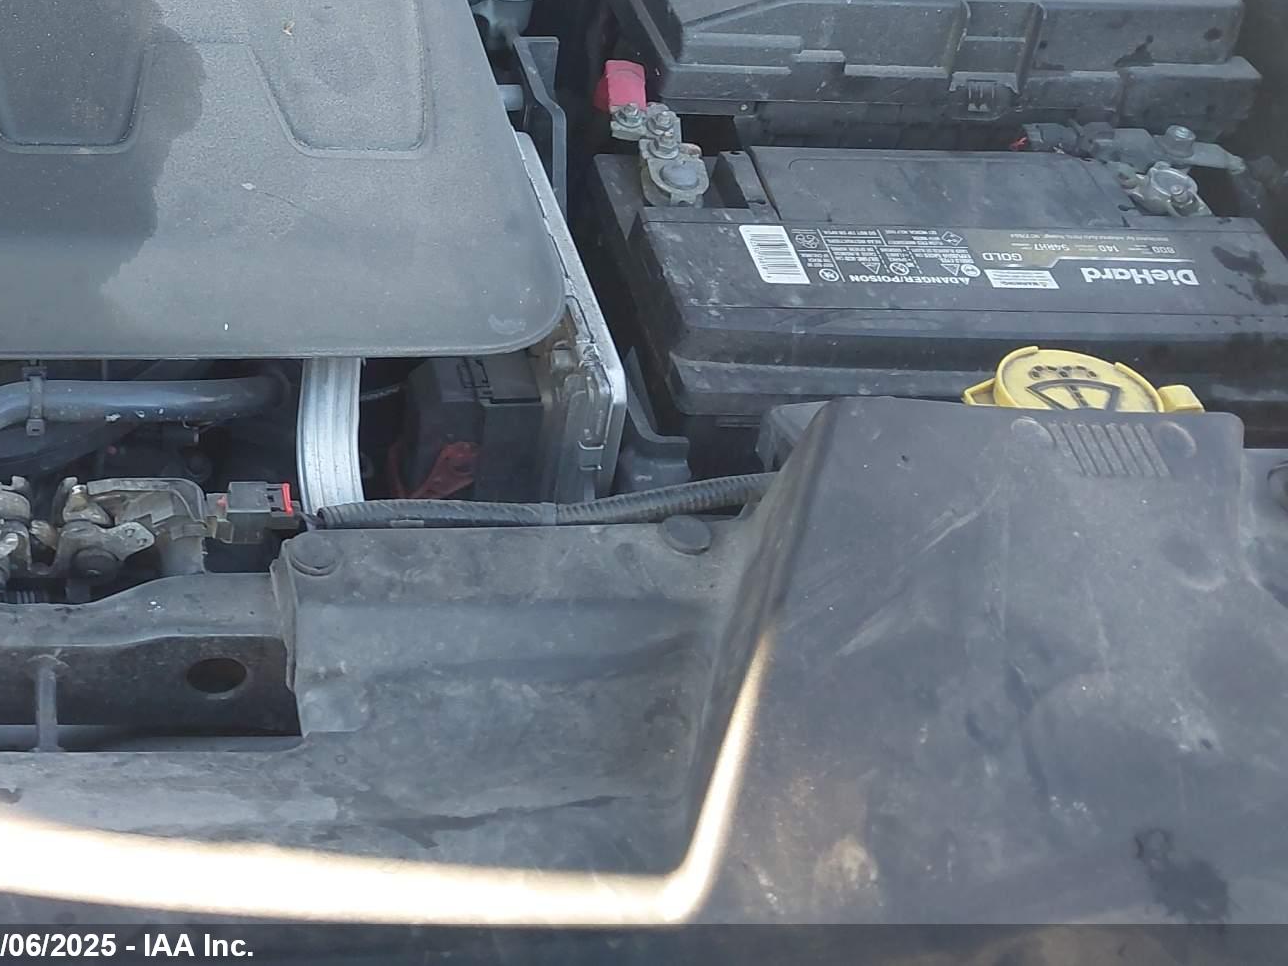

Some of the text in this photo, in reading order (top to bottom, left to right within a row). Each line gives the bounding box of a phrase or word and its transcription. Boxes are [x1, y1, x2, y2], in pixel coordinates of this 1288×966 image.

[1098, 244, 1120, 253] 140
[982, 252, 1024, 262] GOLD
[1081, 266, 1200, 285] DieHard
